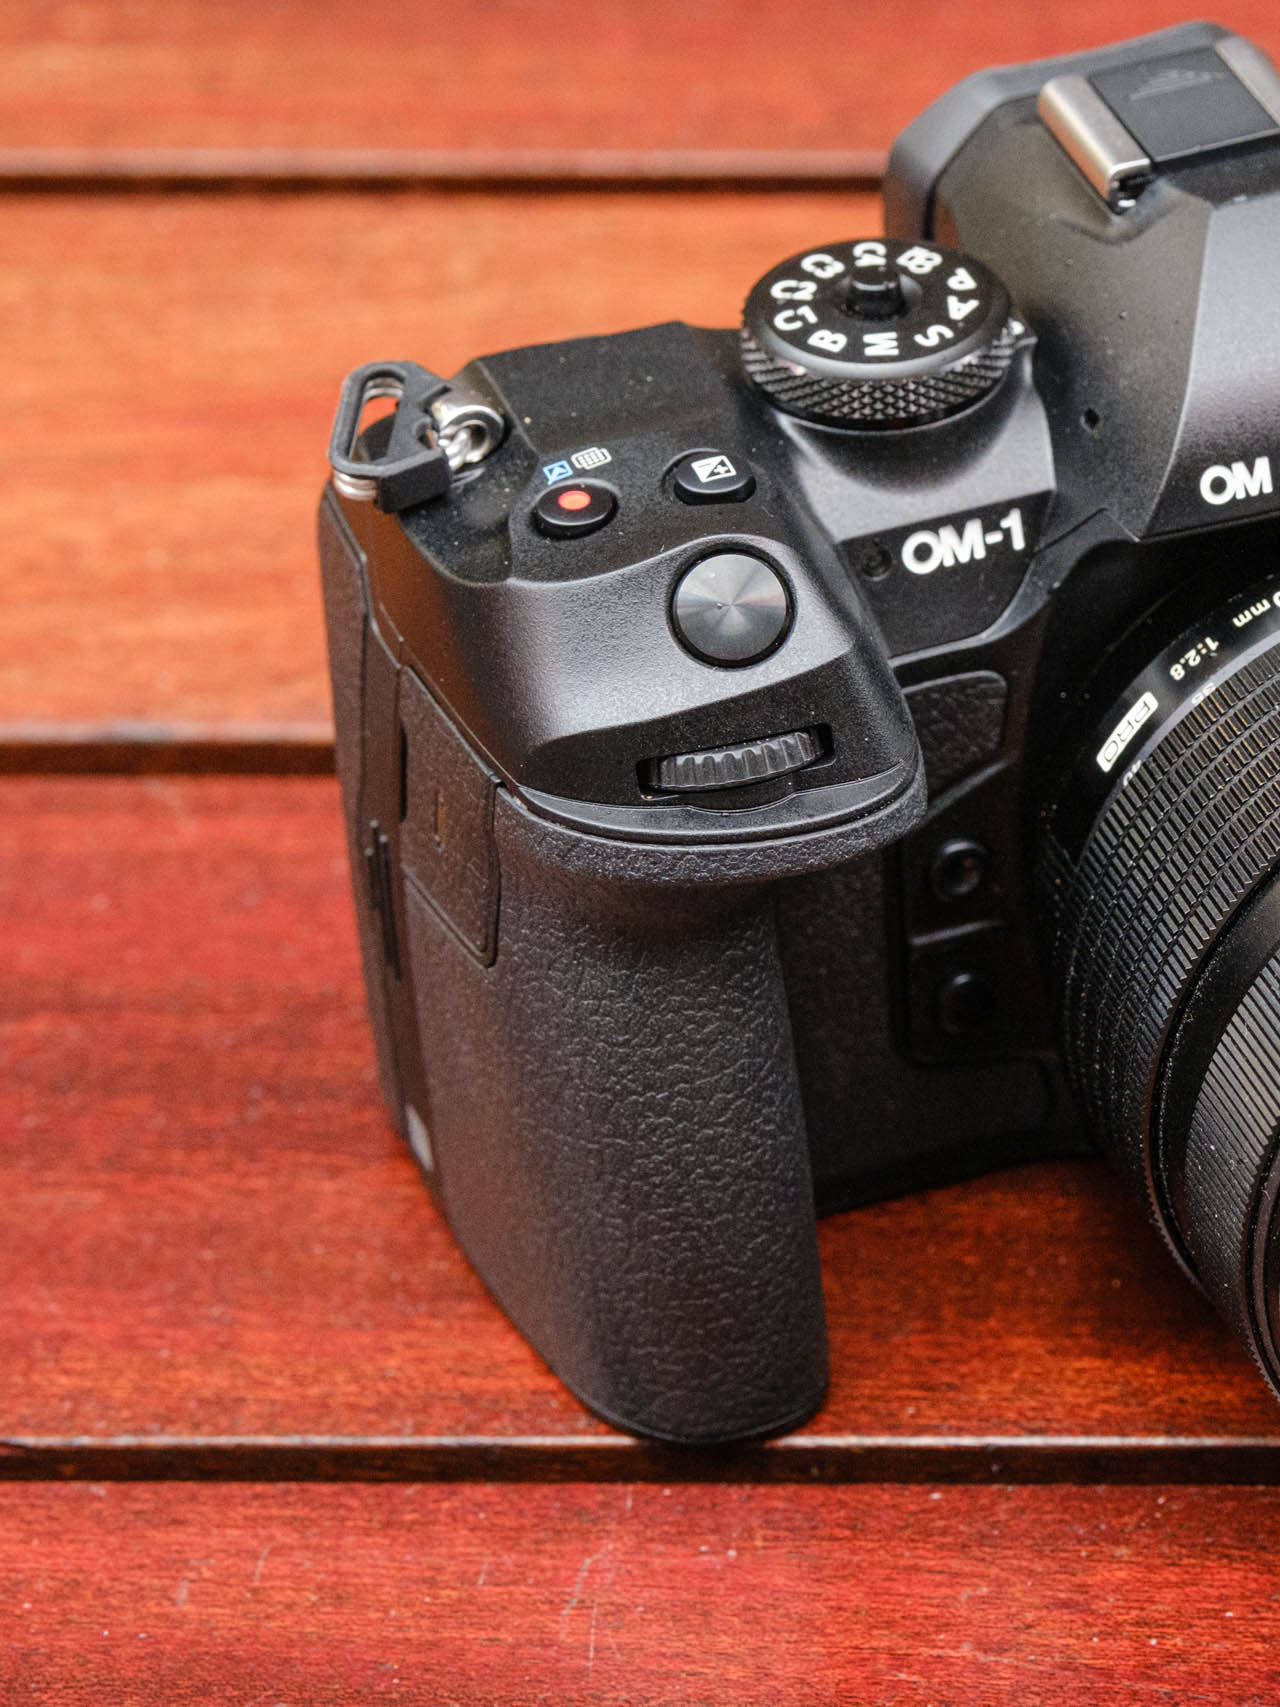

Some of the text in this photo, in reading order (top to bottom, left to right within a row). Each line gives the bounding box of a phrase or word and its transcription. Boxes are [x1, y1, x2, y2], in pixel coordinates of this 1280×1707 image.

[800, 253, 845, 279] C3
[947, 267, 977, 291] P
[770, 279, 817, 301] C2
[947, 295, 979, 321] A
[807, 329, 848, 353] B
[863, 331, 899, 357] M
[914, 324, 954, 347] S
[1199, 456, 1274, 505] OM
[901, 508, 1026, 575] OM-1
[1169, 637, 1219, 681] 1:2.8
[1102, 700, 1152, 763] PRO
